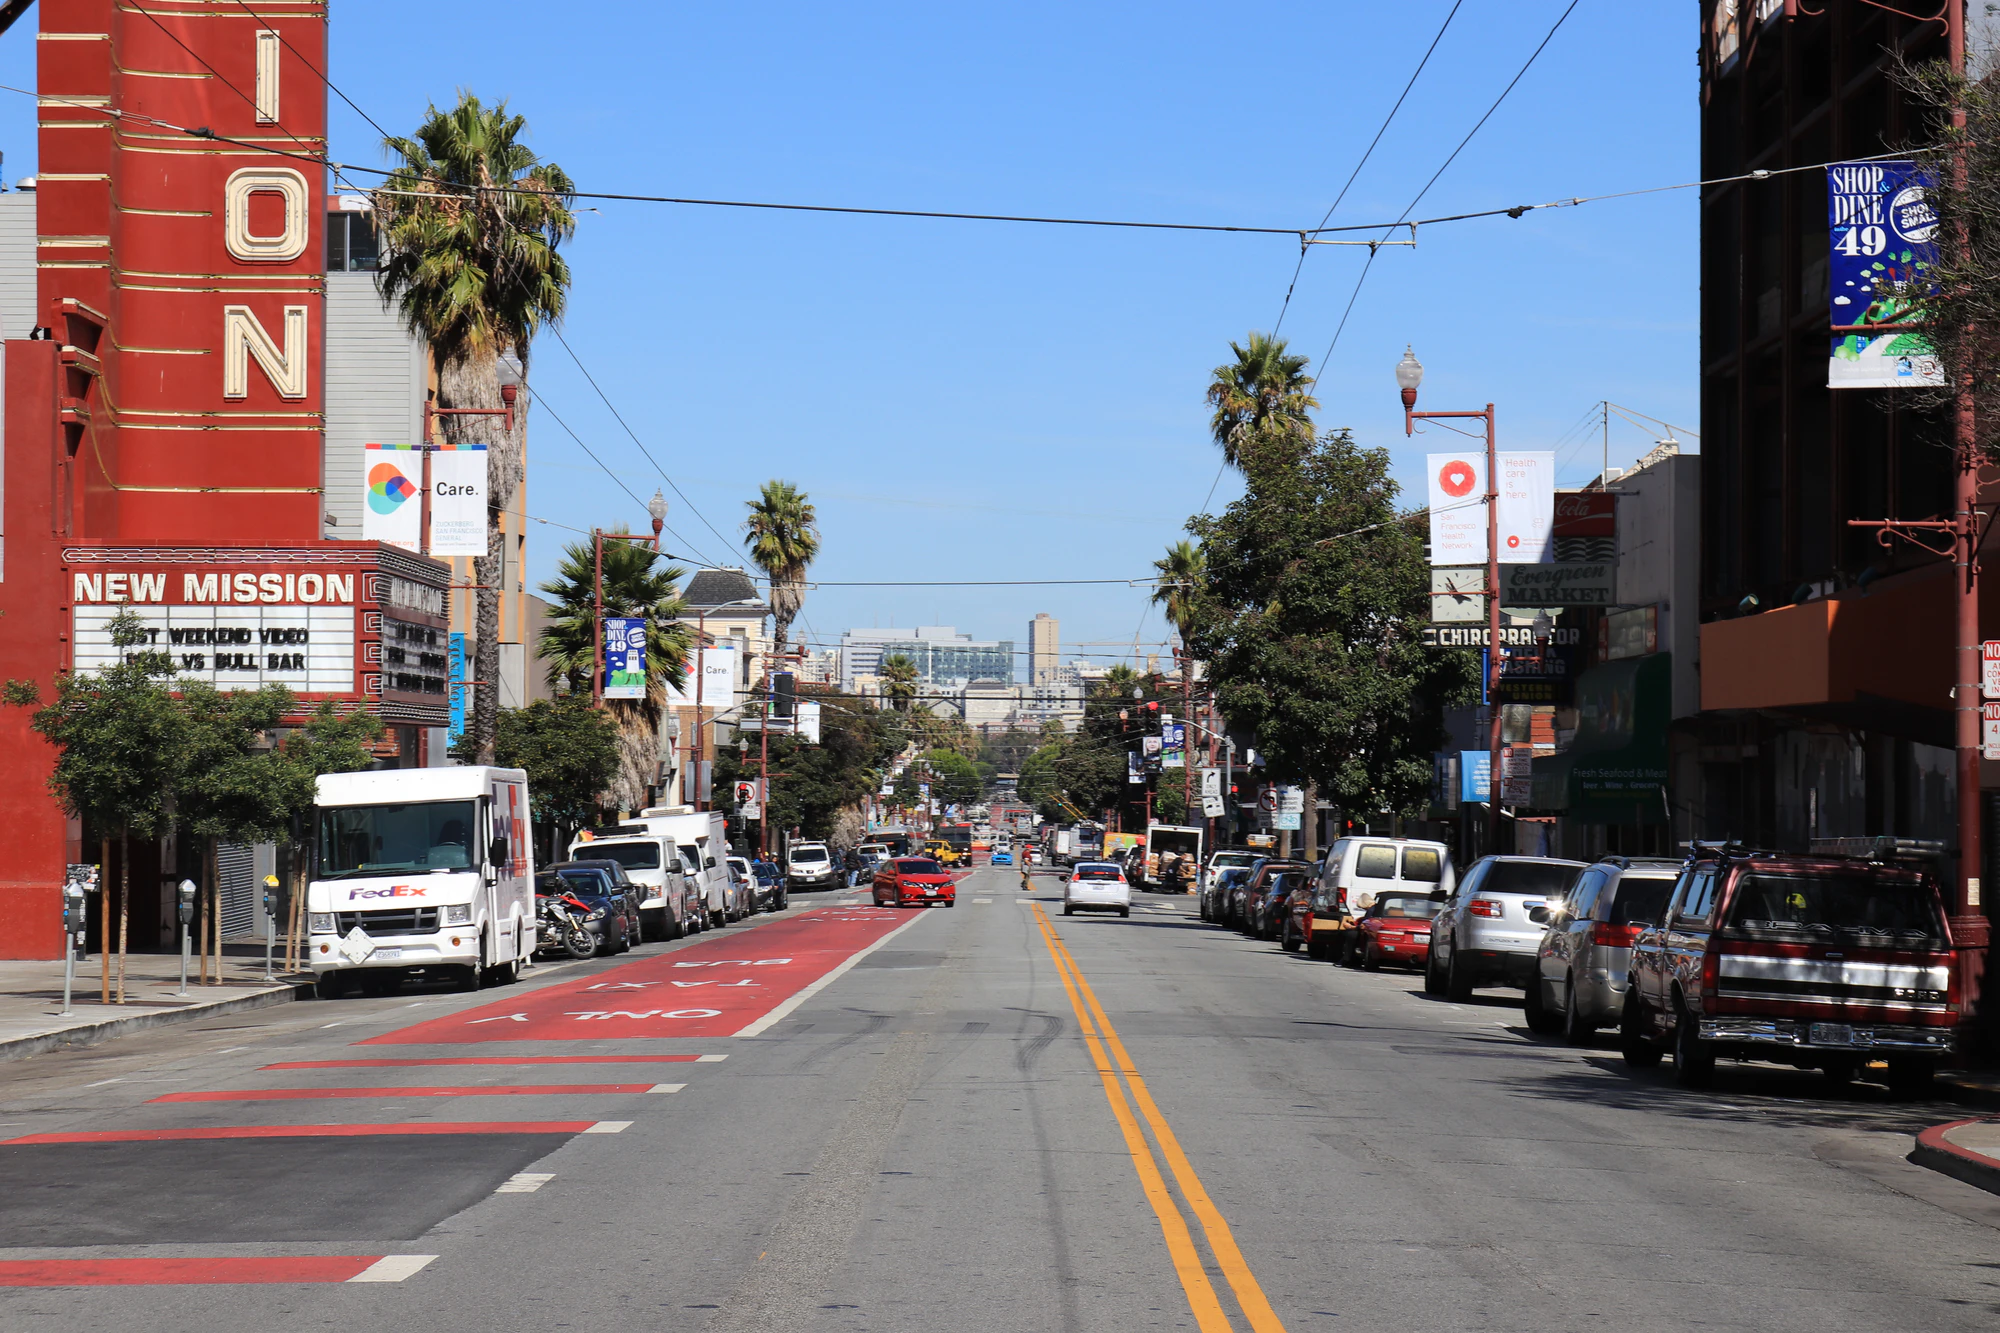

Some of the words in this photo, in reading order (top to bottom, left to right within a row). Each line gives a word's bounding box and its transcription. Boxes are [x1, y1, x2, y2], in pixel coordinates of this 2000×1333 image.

[1833, 166, 1884, 194] SHOP
[1833, 195, 1885, 225] DINE
[1833, 226, 1887, 256] 49
[1506, 459, 1537, 467] Health
[1506, 470, 1526, 478] care
[436, 482, 479, 496] Care.
[1506, 491, 1527, 499] here
[1441, 532, 1466, 540] Health
[1441, 542, 1473, 550] Network
[1510, 564, 1606, 590] Evergreen
[73, 573, 167, 603] NEW
[183, 573, 355, 603] MISSION
[1507, 588, 1609, 603] MARKET
[606, 620, 627, 629] SHOP
[169, 628, 252, 645] WEEKEND
[259, 628, 310, 645] VIDEO
[606, 630, 627, 640] DINE
[606, 641, 627, 652] 49
[182, 653, 205, 669] VS
[215, 653, 259, 669] BULL
[268, 653, 305, 669] BAR
[705, 666, 729, 675] Care.
[1512, 692, 1553, 700] UNION
[1573, 768, 1597, 778] Fresh
[1598, 768, 1635, 778] Seafood
[1636, 768, 1644, 778] &
[1645, 768, 1668, 778] Meat
[1629, 782, 1659, 790] Grocery
[348, 885, 428, 900] FedEx
[671, 958, 793, 969] BUS
